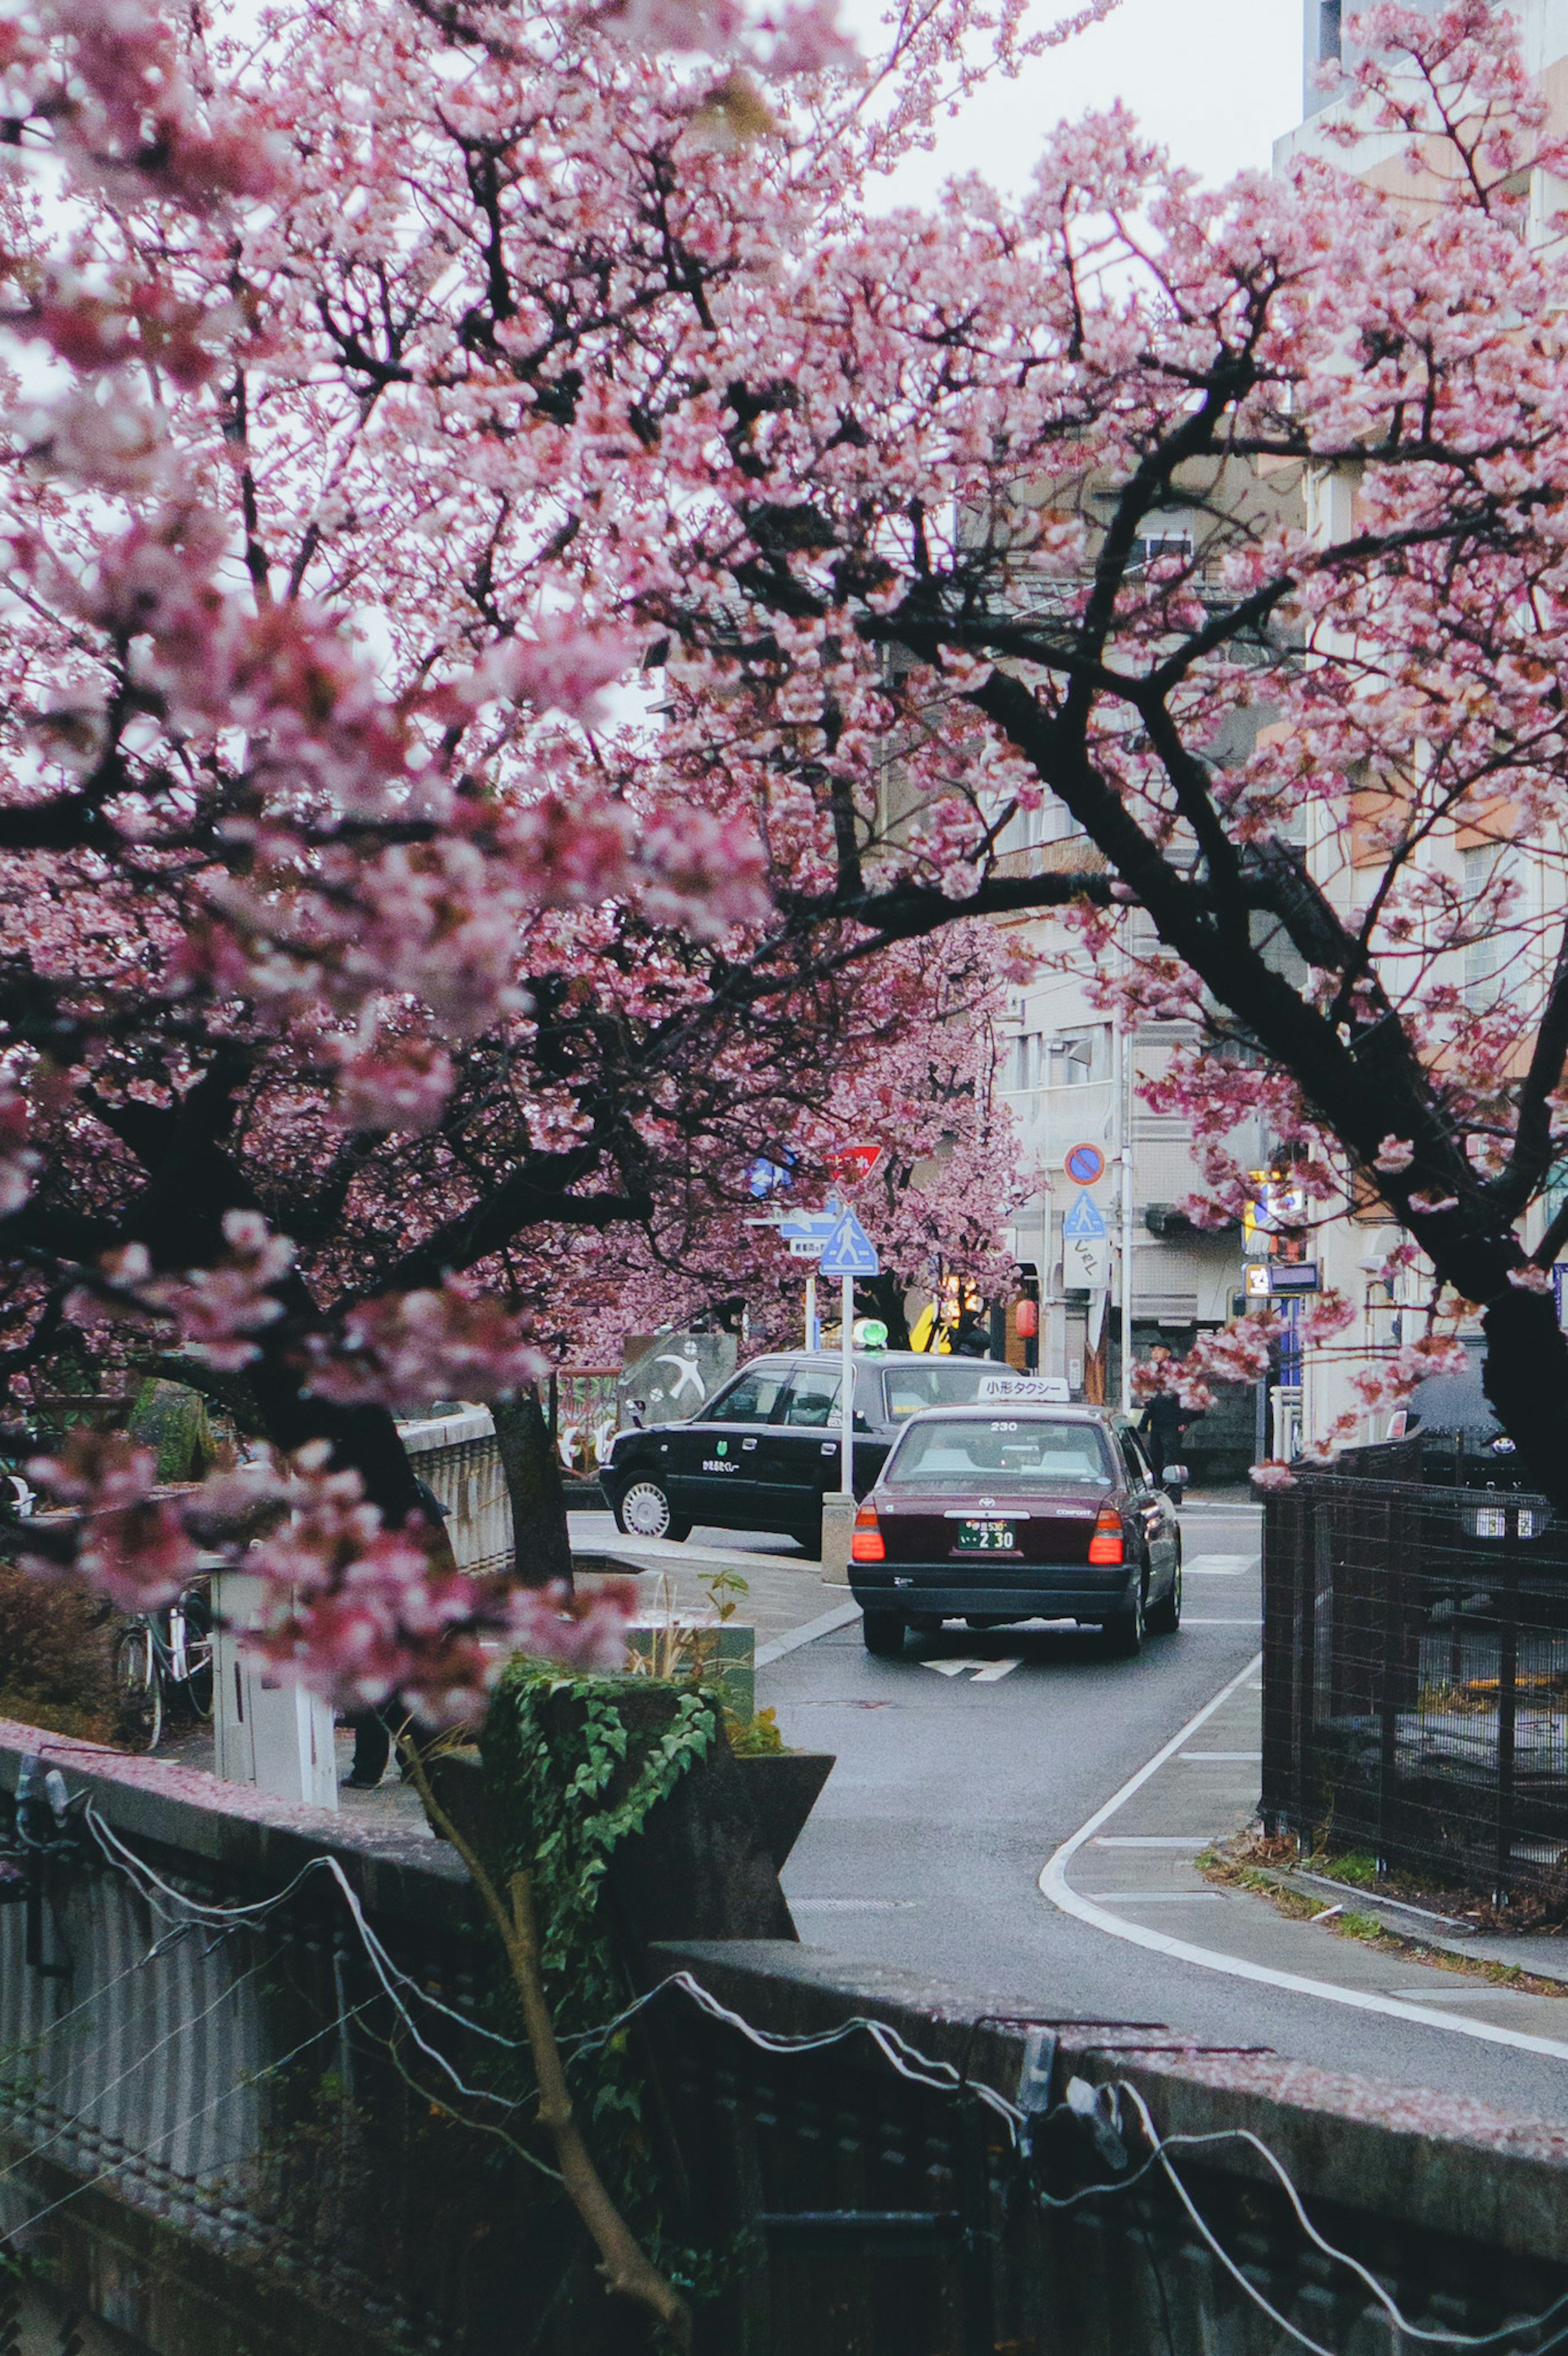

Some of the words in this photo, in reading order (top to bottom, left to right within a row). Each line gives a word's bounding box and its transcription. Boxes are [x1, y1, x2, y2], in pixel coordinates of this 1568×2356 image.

[987, 1381, 1061, 1394] 小形タクシー
[991, 1422, 1018, 1431] 230
